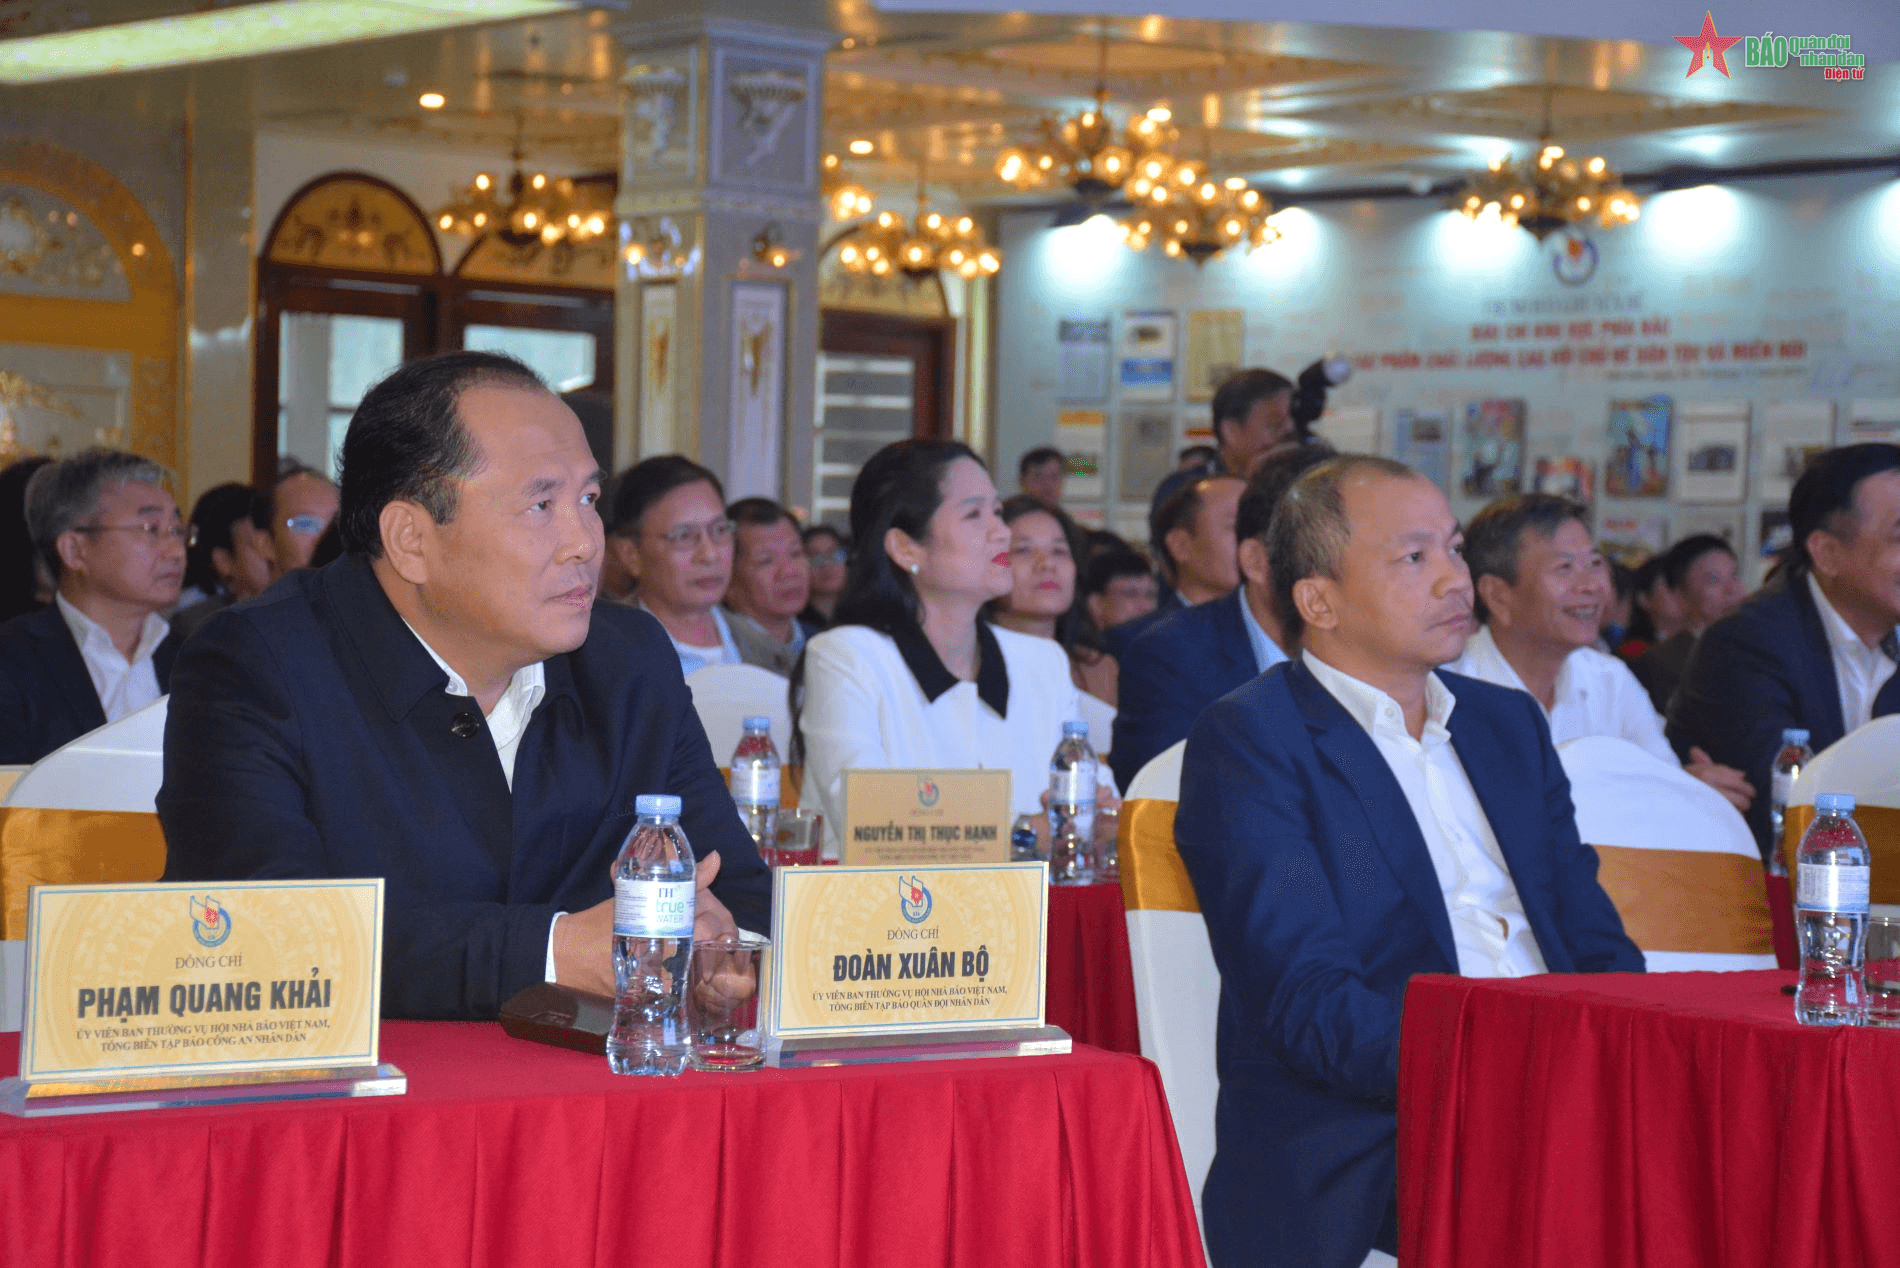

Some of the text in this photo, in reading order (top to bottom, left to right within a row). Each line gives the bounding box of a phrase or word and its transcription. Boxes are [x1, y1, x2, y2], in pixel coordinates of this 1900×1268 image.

[907, 825, 926, 844] THỊ
[655, 899, 685, 913] true
[656, 914, 685, 923] WATER
[920, 926, 940, 940] CHÍ
[218, 953, 243, 968] CHÍ
[833, 944, 990, 982] ĐOÀN XUÂN BỘ
[77, 967, 332, 1023] PHẠM QUANG KHẢI
[826, 989, 846, 1000] VIÊN
[847, 990, 865, 1000] BAN
[914, 988, 931, 998] HỘI
[948, 986, 966, 996] BÁO
[966, 985, 985, 996] VIỆT
[891, 998, 909, 1010] BÁO
[910, 997, 933, 1010] QUÂN
[934, 997, 950, 1009] ĐỘI
[950, 996, 973, 1007] NHÂN
[973, 995, 991, 1006] DÂN
[94, 1026, 120, 1039] VIÊN
[121, 1027, 144, 1038] BAN
[210, 1022, 230, 1035] HỘI
[255, 1020, 278, 1032] BÁO
[278, 1019, 303, 1031] VIỆT
[182, 1035, 206, 1047] BÁO
[238, 1035, 254, 1045] AN
[254, 1033, 285, 1044] NHÂN
[285, 1031, 307, 1043] DÂN
